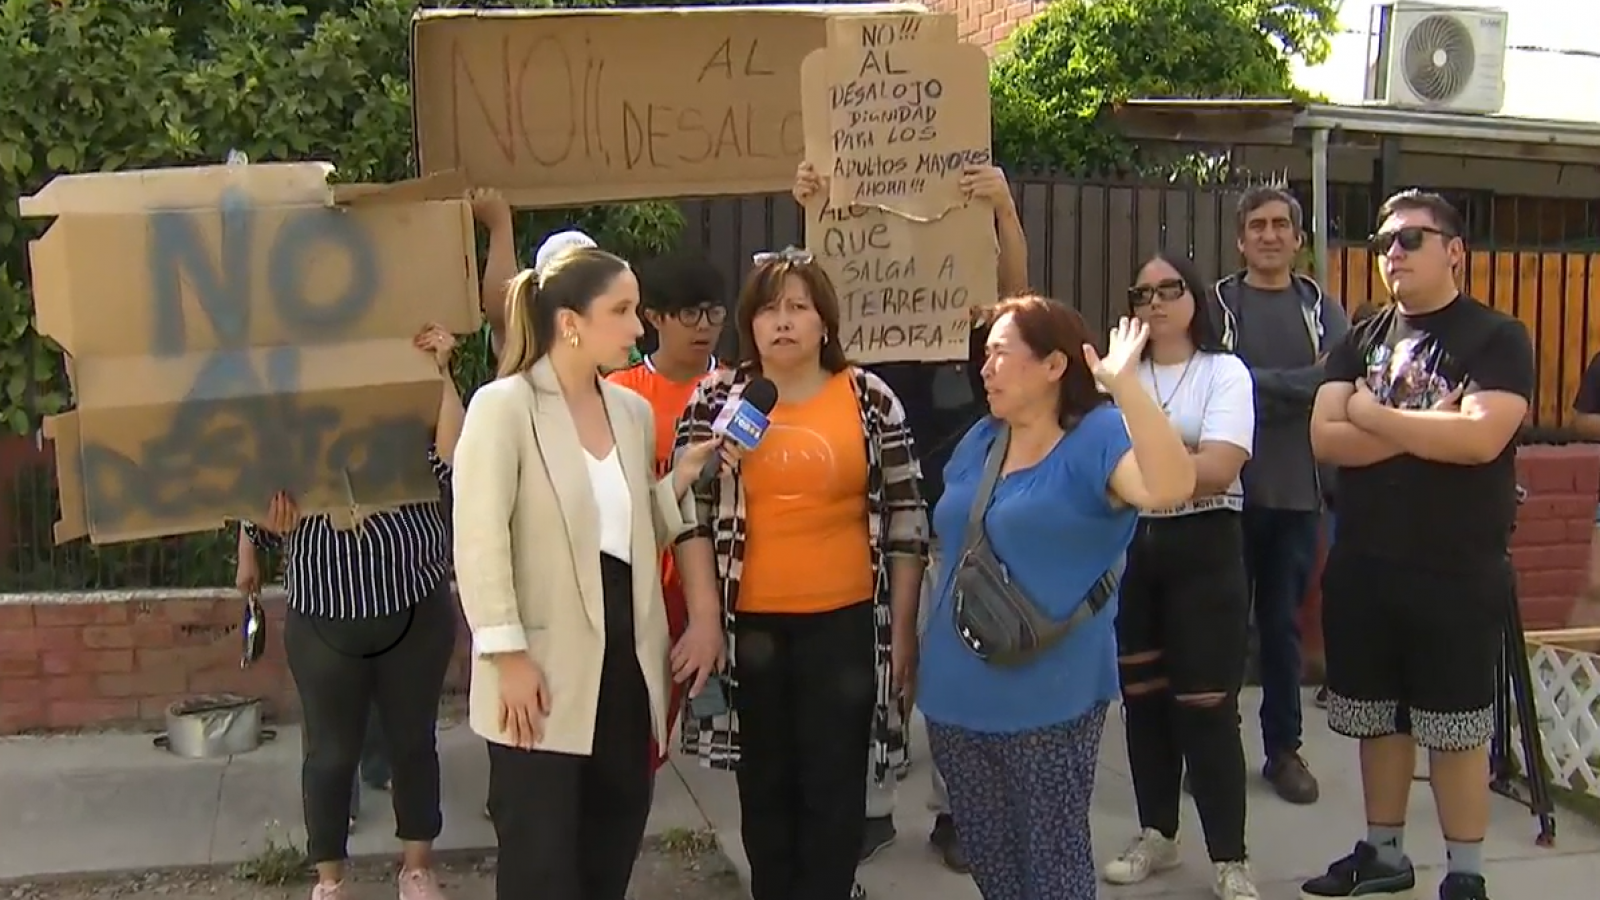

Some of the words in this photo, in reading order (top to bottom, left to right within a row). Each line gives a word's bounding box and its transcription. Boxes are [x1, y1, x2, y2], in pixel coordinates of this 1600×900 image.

[861, 16, 922, 47] NO!!!
[697, 36, 776, 83] AL
[859, 50, 911, 77] AL
[829, 78, 942, 110] DESALOJO
[832, 128, 874, 152] PARA
[886, 126, 937, 144] LOS
[147, 183, 381, 360] NO
[841, 255, 916, 285] SALGA
[937, 253, 954, 281] A
[843, 286, 969, 322] TERRENO
